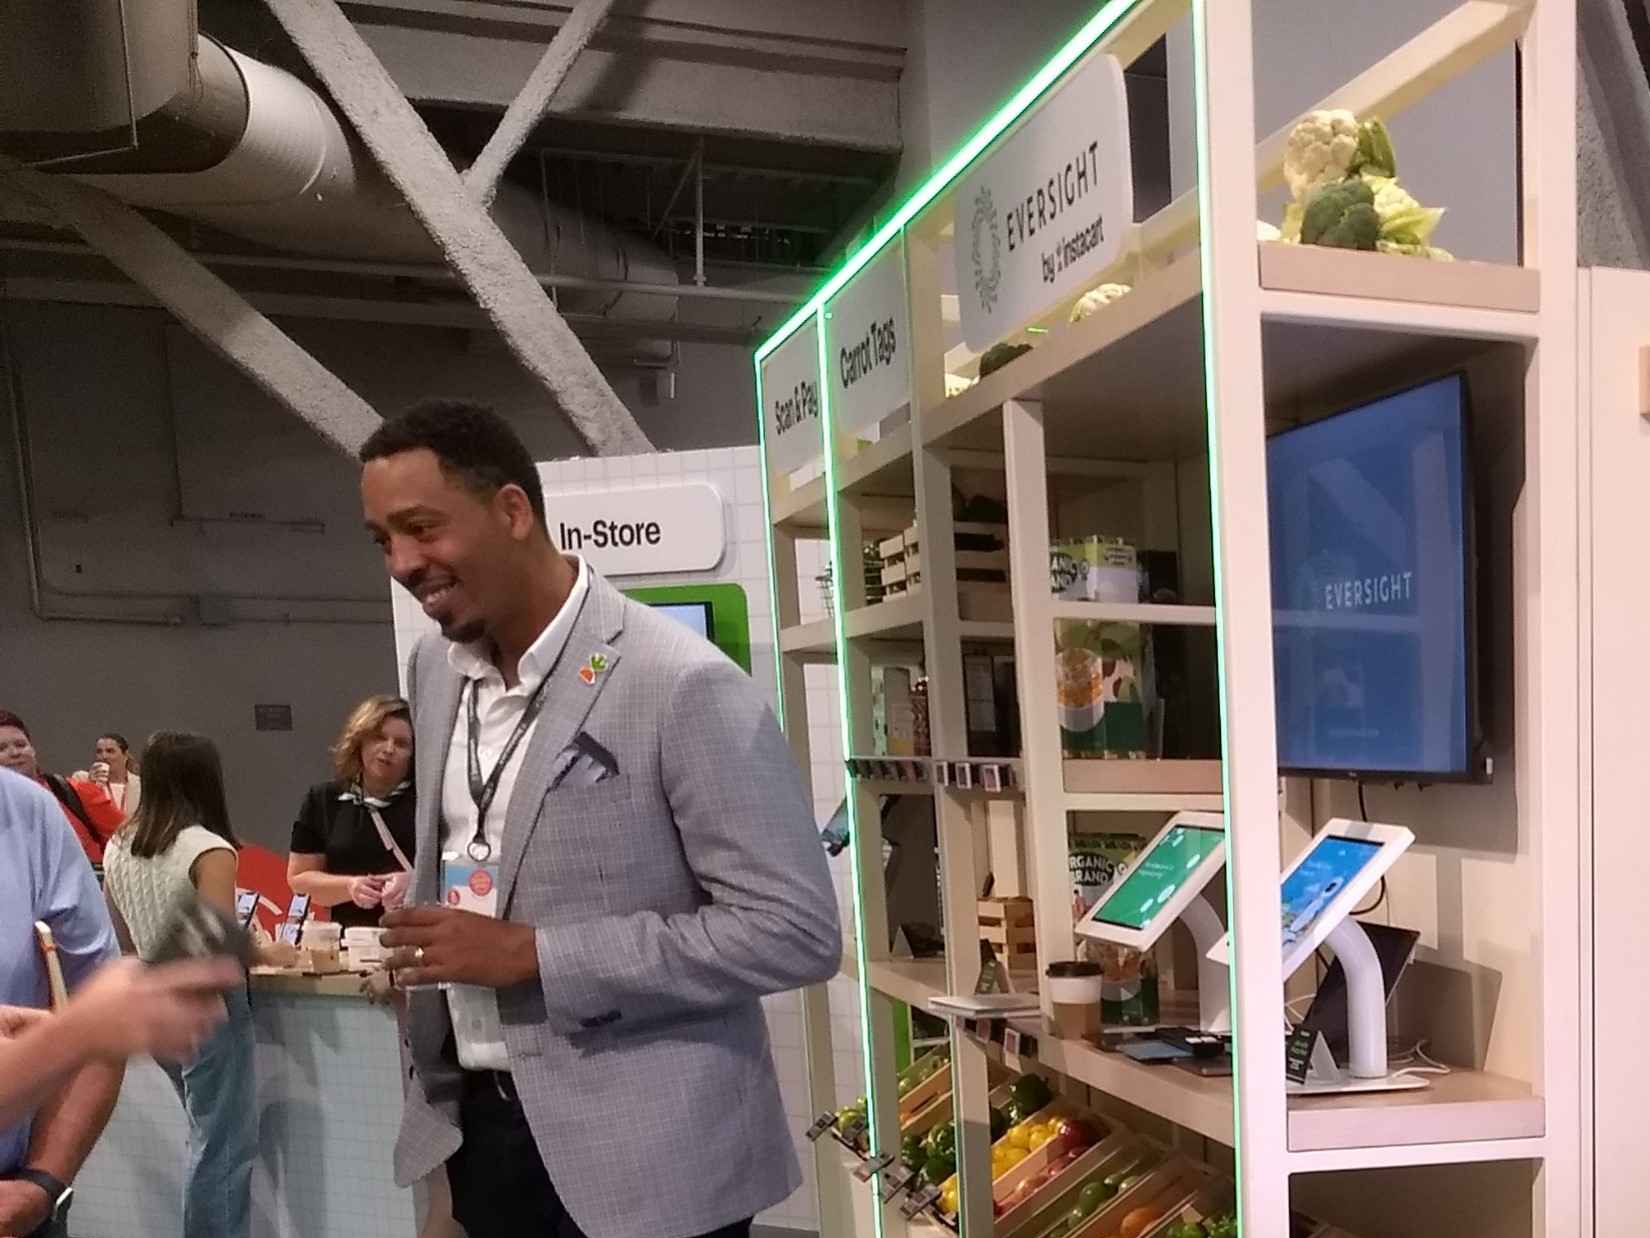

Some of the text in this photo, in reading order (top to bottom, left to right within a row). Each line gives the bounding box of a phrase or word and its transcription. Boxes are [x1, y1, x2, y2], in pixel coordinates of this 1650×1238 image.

[1006, 140, 1098, 252] EVERSIGHT
[1041, 215, 1104, 284] by instacart
[840, 317, 897, 389] Carrot Tags
[775, 398, 795, 436] Scan
[801, 380, 819, 418] Pay
[560, 520, 661, 550] In-Store
[1325, 571, 1412, 610] EVERSIGHT
[1069, 855, 1114, 872] RGANIC
